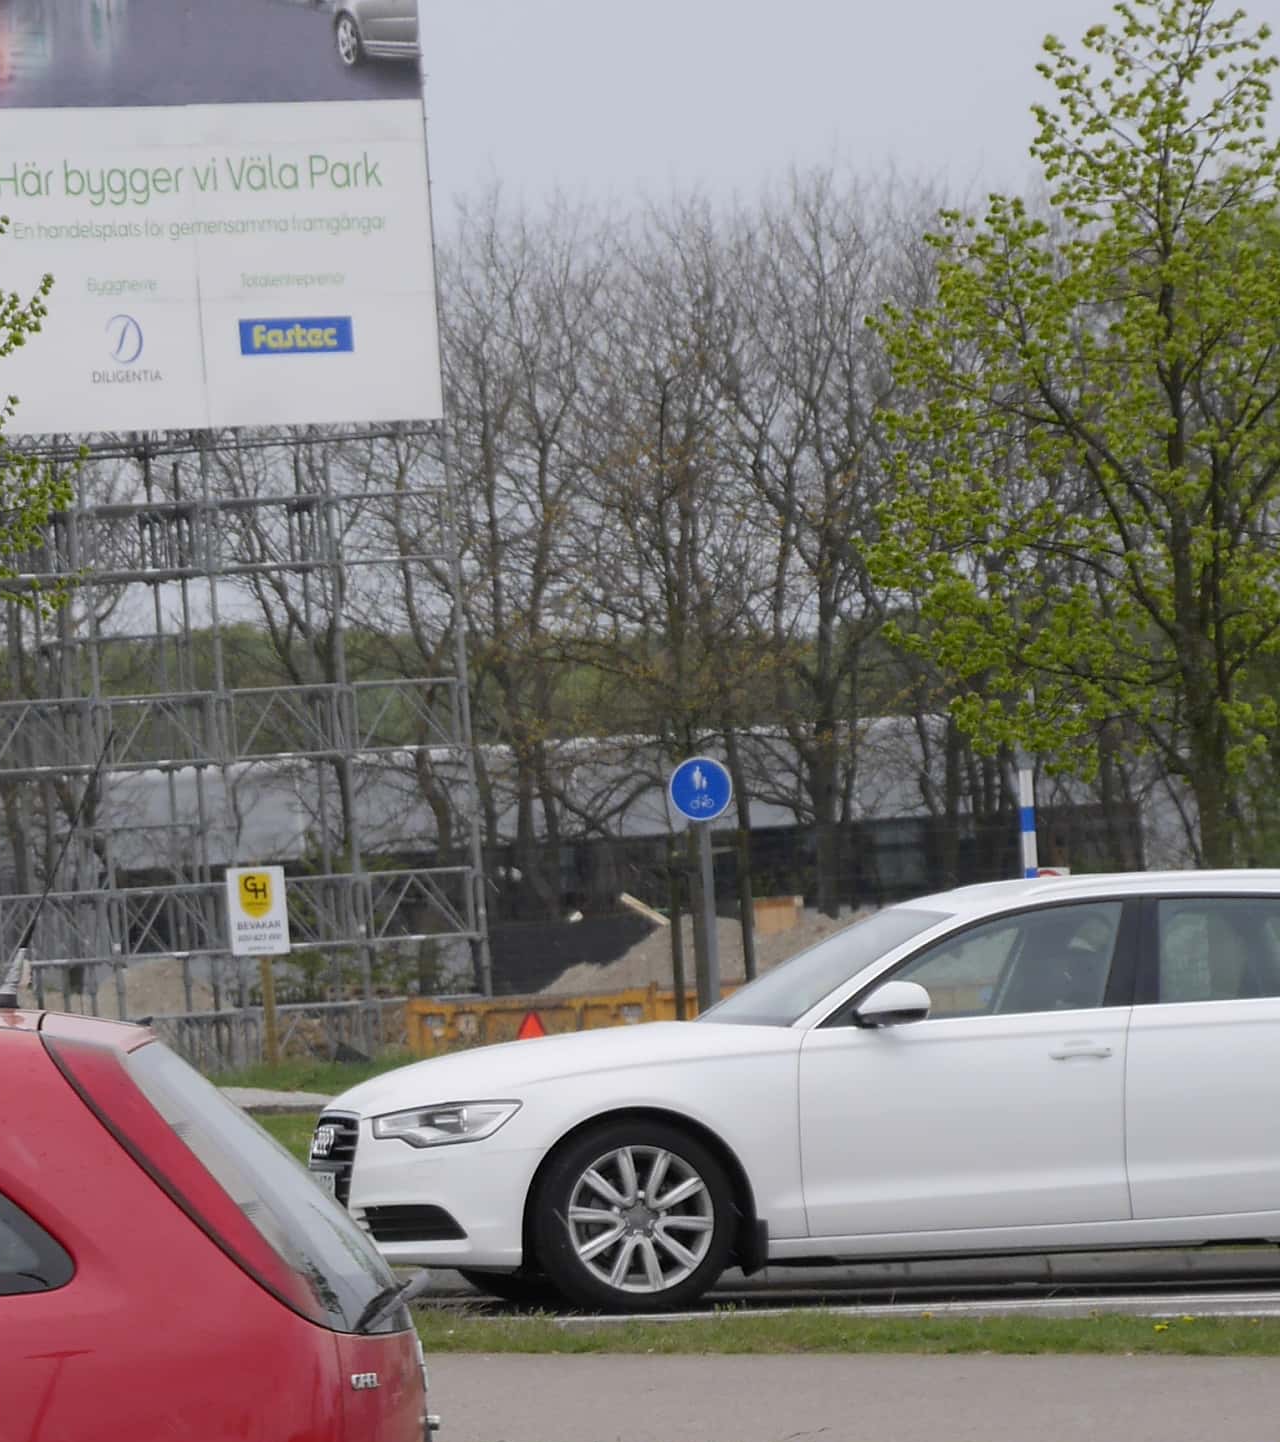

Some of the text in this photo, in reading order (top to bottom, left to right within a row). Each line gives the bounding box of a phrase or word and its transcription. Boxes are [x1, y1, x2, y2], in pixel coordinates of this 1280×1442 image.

[63, 159, 184, 206] bygger
[192, 156, 218, 192] vi
[225, 152, 300, 191] Väla
[308, 151, 383, 189] Park
[13, 221, 35, 240] En
[38, 217, 141, 243] handelsplats
[168, 219, 289, 242] gemensamma
[252, 323, 338, 350] Fastec
[91, 368, 164, 385] DILIGENTIA
